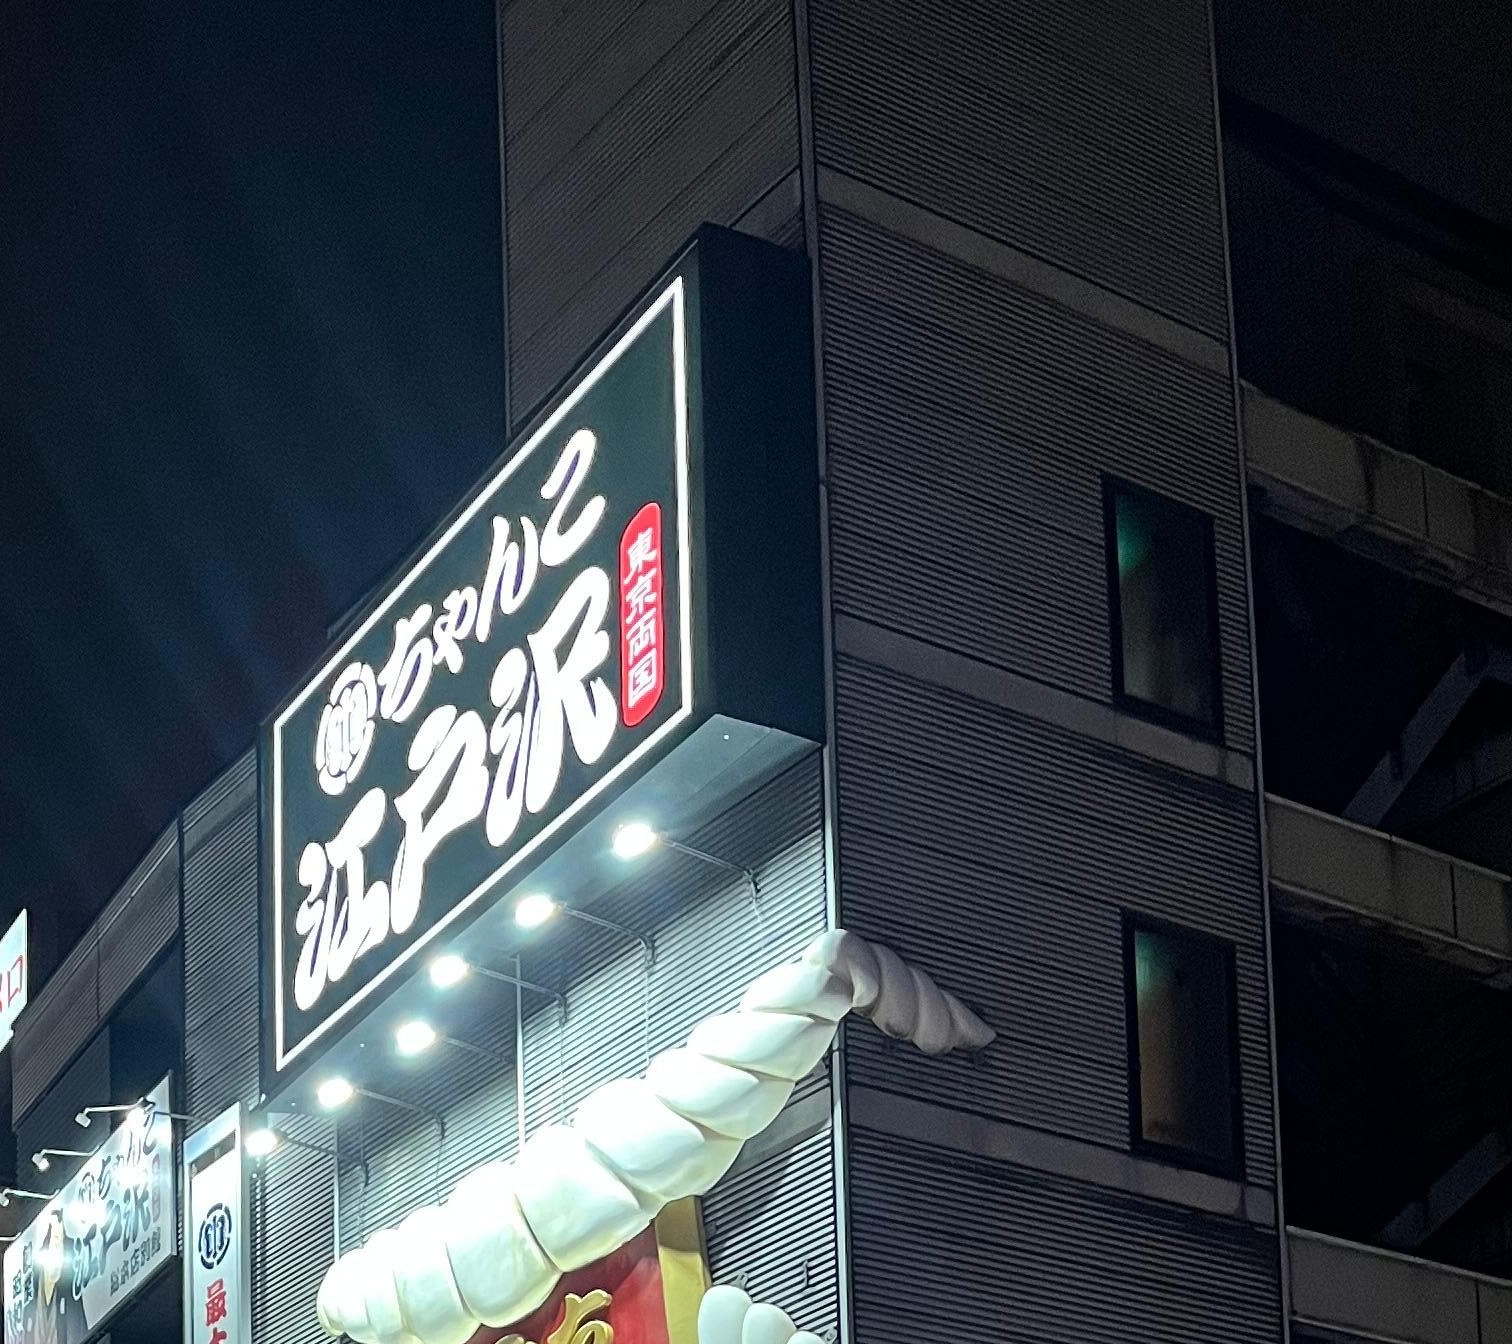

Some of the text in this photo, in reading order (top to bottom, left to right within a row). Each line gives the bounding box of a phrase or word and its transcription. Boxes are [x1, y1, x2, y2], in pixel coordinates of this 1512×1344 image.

[381, 427, 606, 724] ちゃんこ
[622, 529, 661, 708] 東京両国
[293, 565, 617, 1012] 江戸沢
